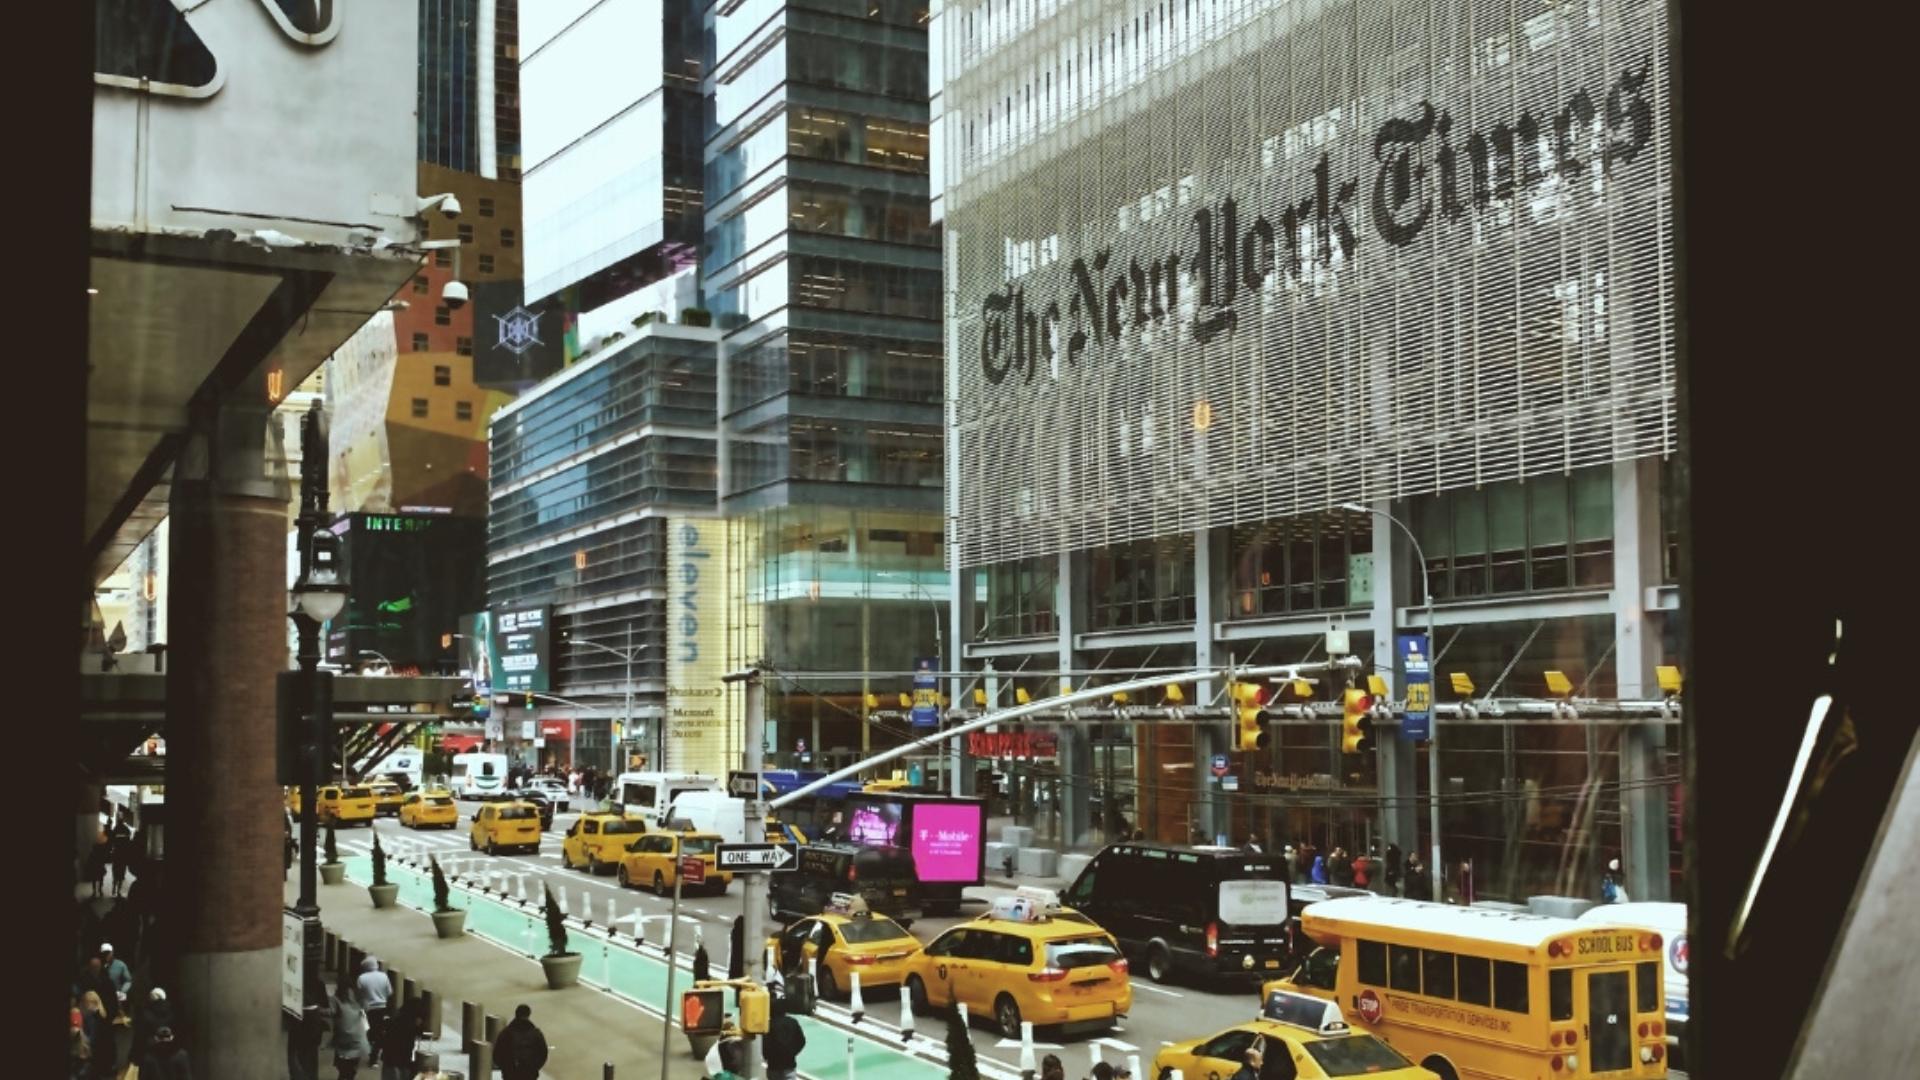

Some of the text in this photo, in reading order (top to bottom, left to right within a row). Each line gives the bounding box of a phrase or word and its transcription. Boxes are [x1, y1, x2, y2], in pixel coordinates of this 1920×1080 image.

[981, 57, 1650, 385] The New York Times
[677, 524, 710, 662] eleven
[727, 851, 785, 863] ONE WAY
[1578, 935, 1633, 954] SCHOOL BUS
[1361, 998, 1379, 1012] STOP
